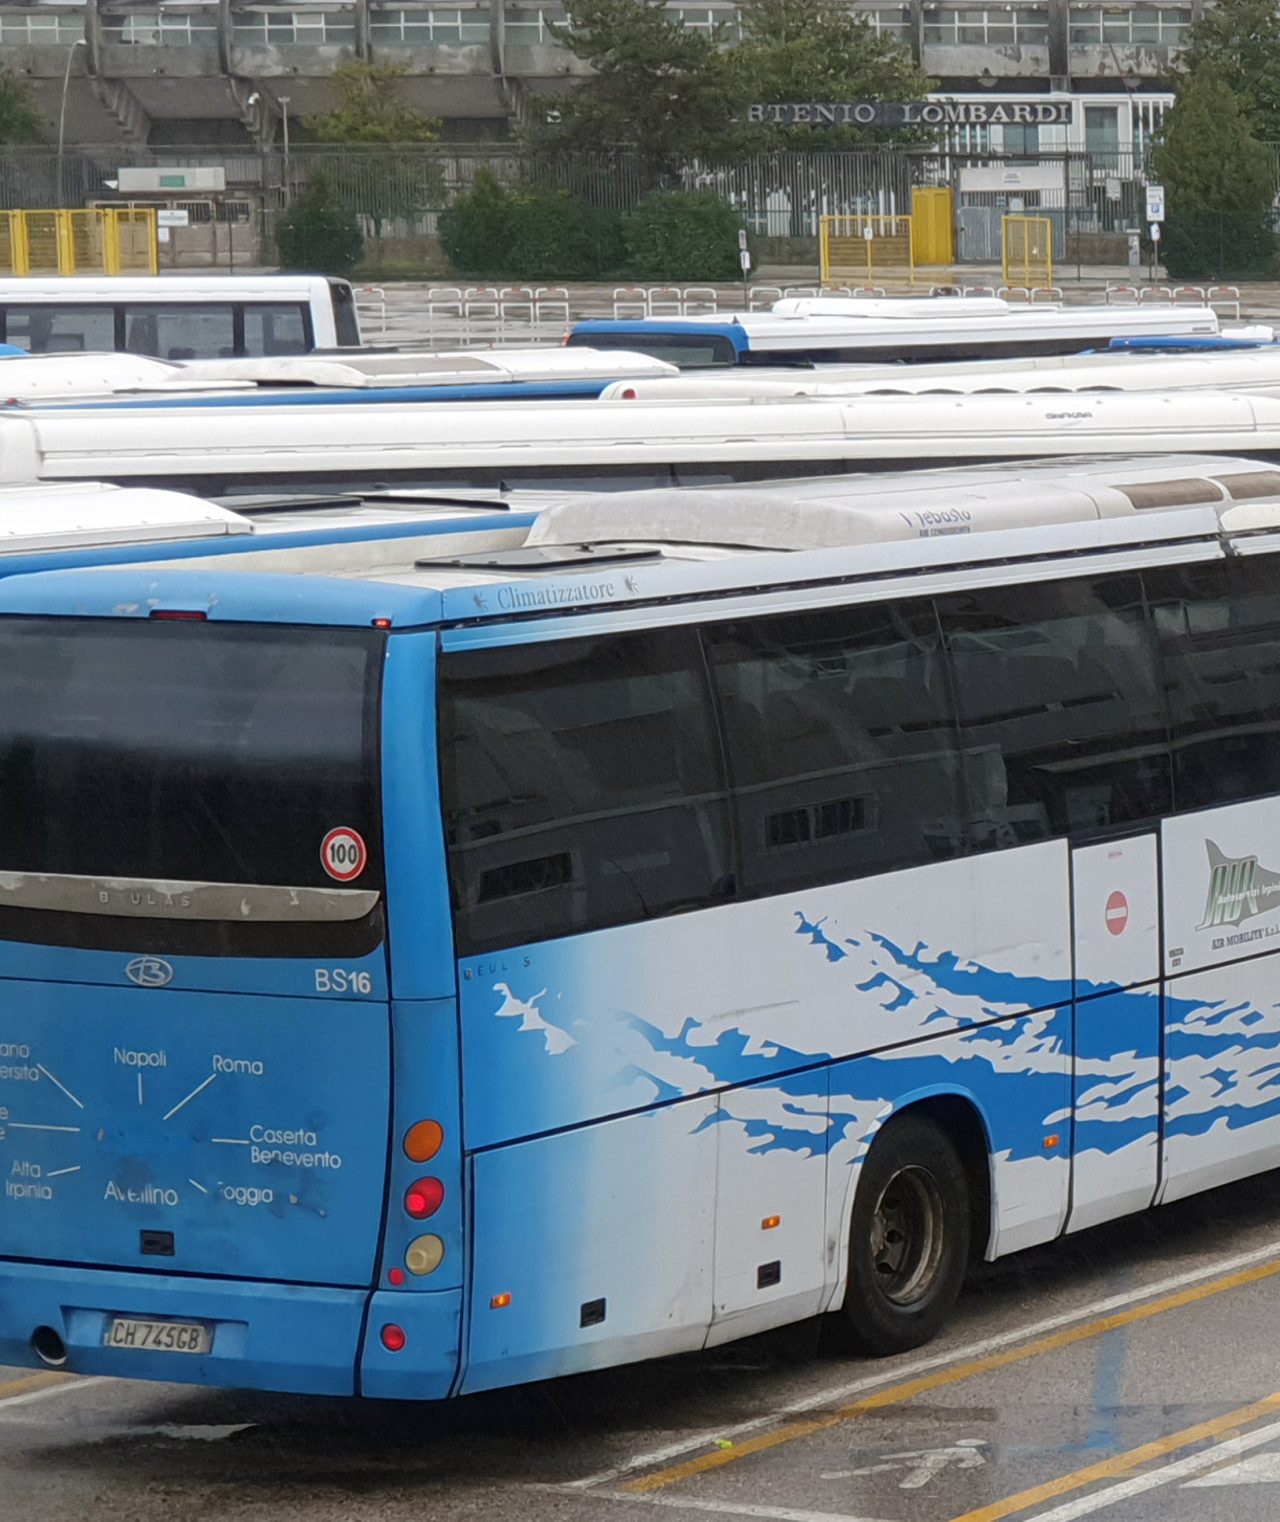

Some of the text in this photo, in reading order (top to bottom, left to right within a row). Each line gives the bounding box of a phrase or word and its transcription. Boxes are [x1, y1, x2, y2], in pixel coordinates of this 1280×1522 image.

[748, 103, 1071, 123] RTENIO LOMBARDI
[497, 581, 616, 610] Climatizzatore
[330, 842, 357, 864] 100
[99, 891, 191, 908] BULAS
[1211, 938, 1225, 950] AIR
[315, 968, 372, 994] BS16
[113, 1046, 167, 1068] Napoli
[212, 1054, 264, 1075] Roma
[249, 1124, 317, 1146] Caserta
[250, 1145, 342, 1169] Benevento
[11, 1159, 42, 1178] Alta
[5, 1179, 53, 1200] Irpinia
[217, 1180, 274, 1206] oggia
[113, 1321, 200, 1350] CH 745GB
